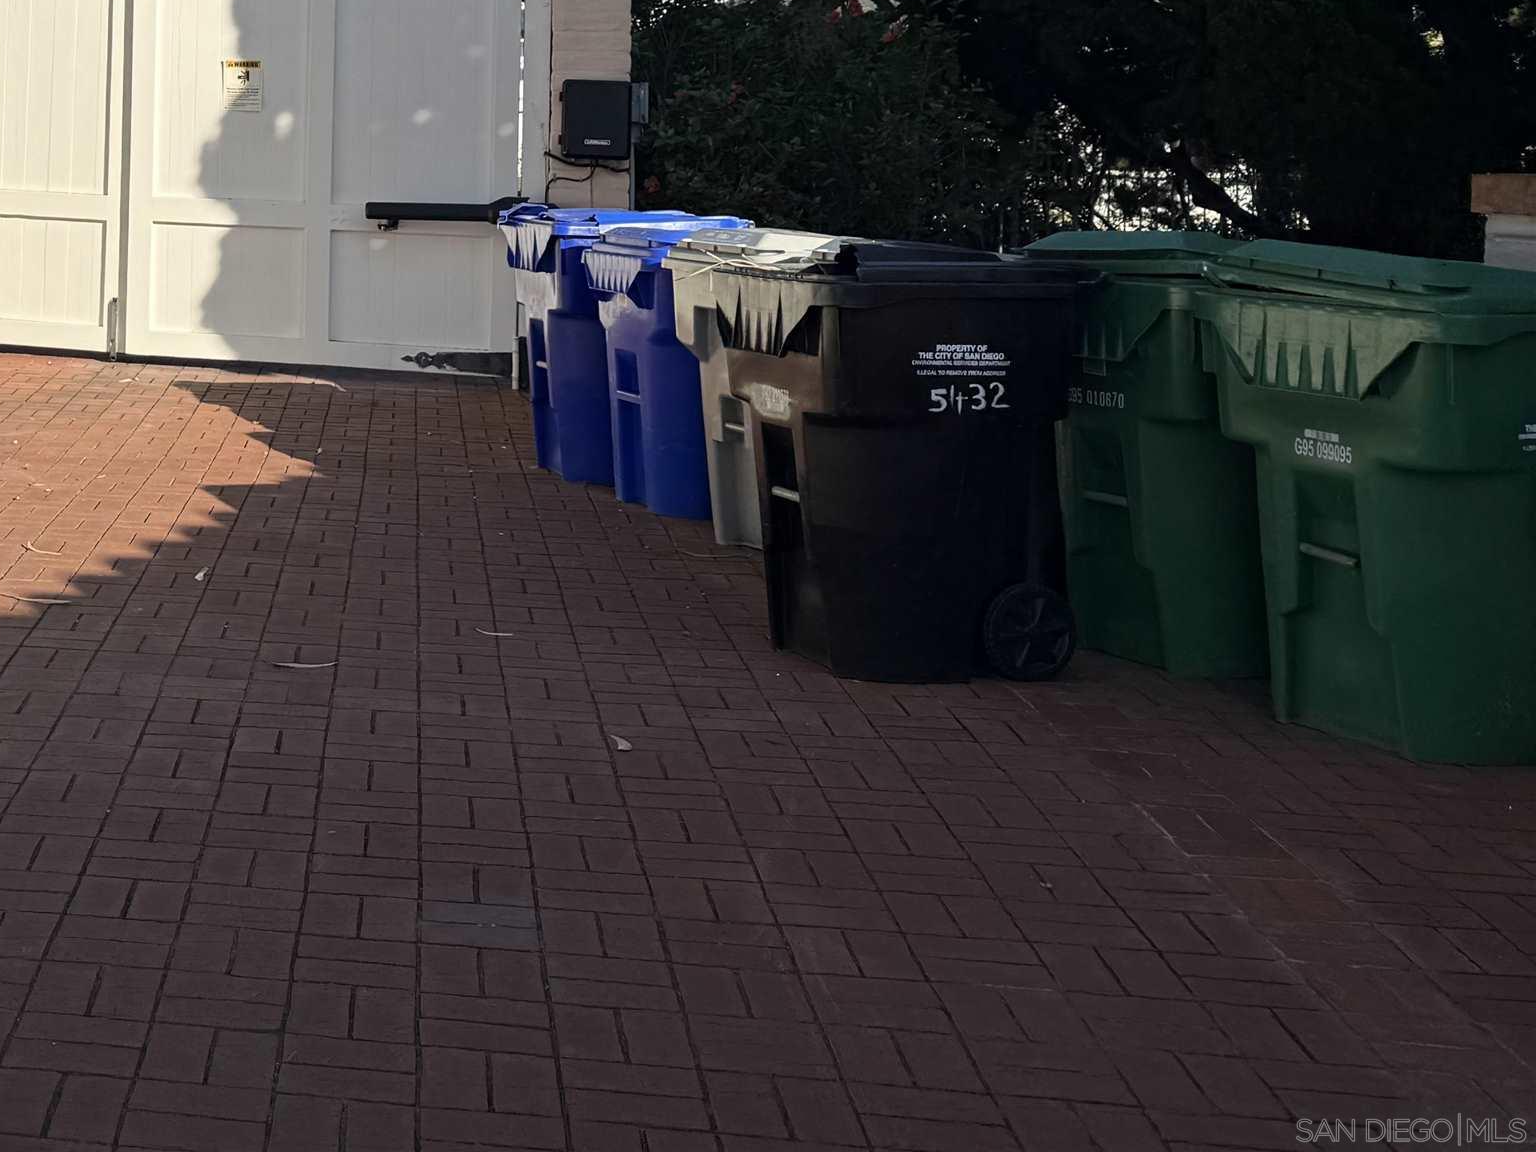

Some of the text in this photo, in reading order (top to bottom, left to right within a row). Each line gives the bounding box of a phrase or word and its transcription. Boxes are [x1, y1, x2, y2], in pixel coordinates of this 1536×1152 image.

[935, 352, 952, 360] CITY
[953, 352, 964, 360] OF
[965, 352, 980, 360] SAN
[936, 344, 988, 352] PROPERTY OF
[928, 382, 1011, 415] 5432
[1295, 437, 1352, 464] G95 099095
